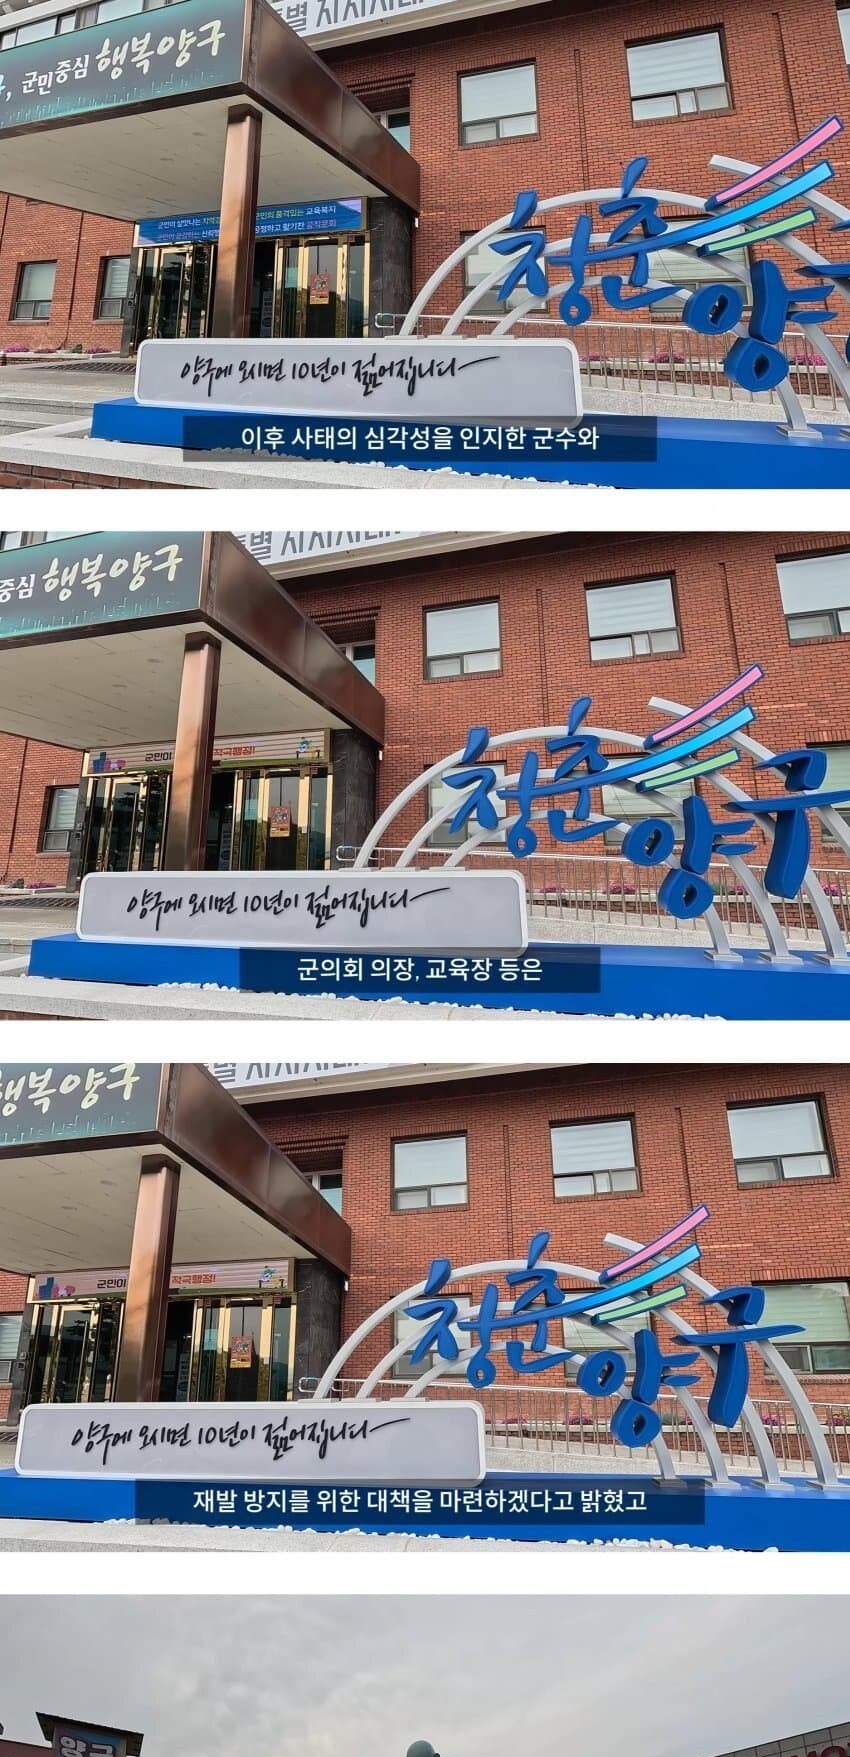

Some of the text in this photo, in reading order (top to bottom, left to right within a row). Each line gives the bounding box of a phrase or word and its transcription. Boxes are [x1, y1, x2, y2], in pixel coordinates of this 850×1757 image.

[21, 53, 90, 96] 군민중심
[179, 352, 475, 398] 양구에 오시면 10년이 젊어집니다
[621, 748, 850, 920] 양구
[126, 884, 425, 931] 양구에 오시면 10년이 젊어집니다
[577, 1286, 807, 1448] 양구
[70, 1416, 387, 1466] 양구에 오시면 10년이 젊어집니다
